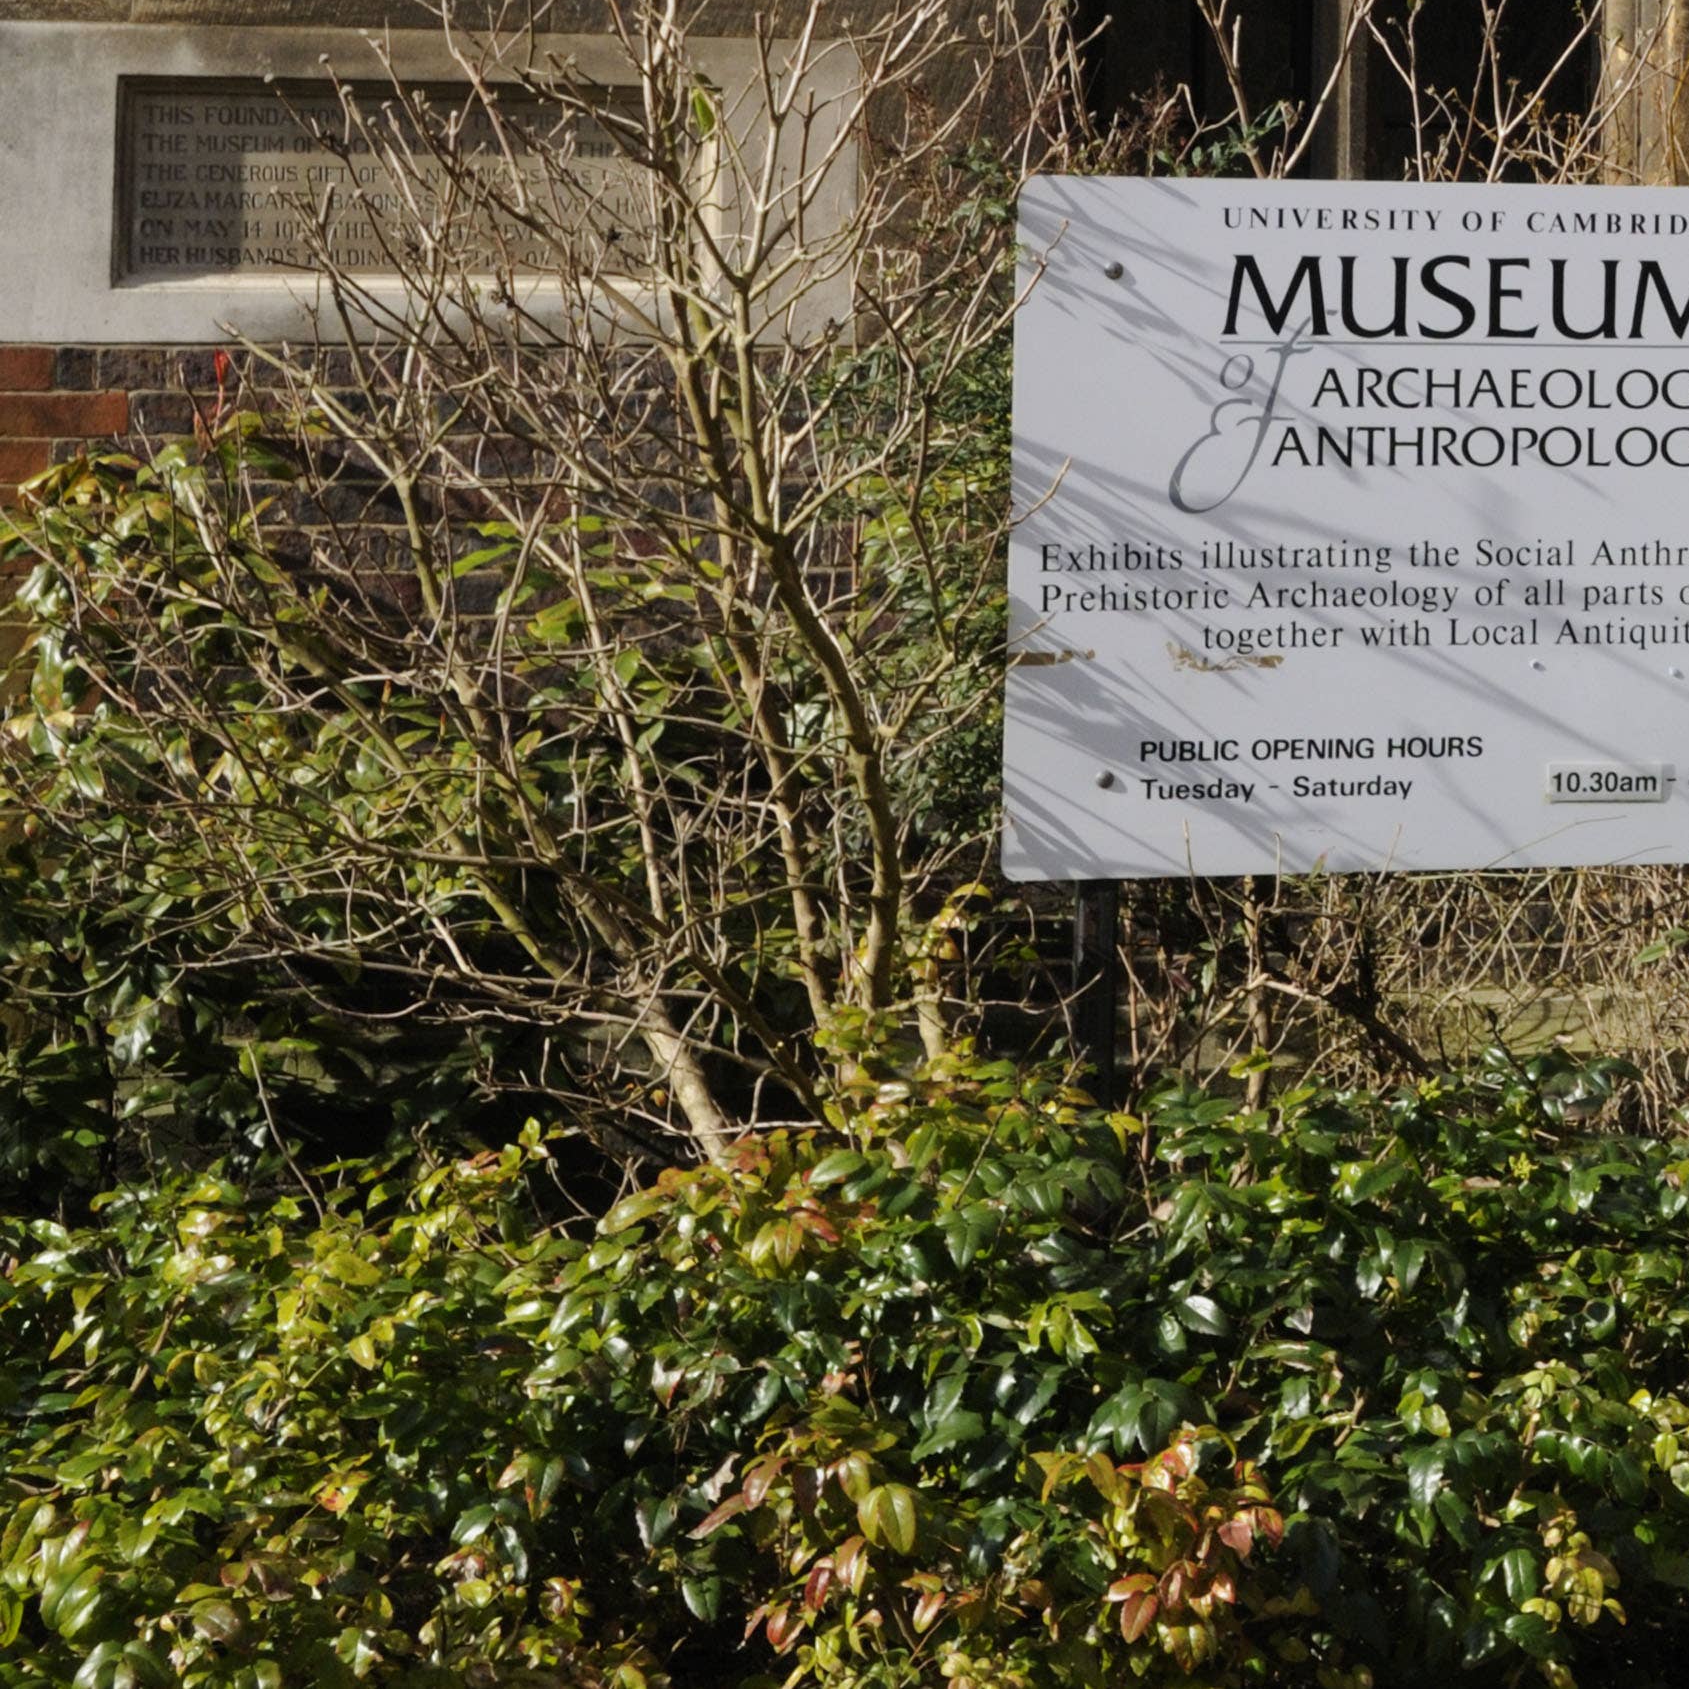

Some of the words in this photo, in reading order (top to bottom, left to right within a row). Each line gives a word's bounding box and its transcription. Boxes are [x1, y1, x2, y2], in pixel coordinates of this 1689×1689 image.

[144, 106, 194, 124] THIS
[143, 134, 188, 152] THE
[196, 136, 283, 153] MUSEUM
[143, 164, 188, 182] THE
[358, 165, 382, 183] OF
[140, 190, 198, 209] ELIZA
[140, 220, 173, 238] ON
[184, 221, 236, 238] MAY
[1223, 207, 1443, 232] UNIVERSITY
[1461, 210, 1507, 232] OF
[140, 248, 179, 265] HER
[1040, 542, 1184, 572] Exhibits
[1200, 540, 1393, 572] illustrating
[1409, 540, 1460, 567] the
[1475, 539, 1575, 567] Social
[1041, 581, 1229, 611] Prehistoric
[1245, 580, 1459, 611] Archaeology
[1474, 578, 1510, 606] of
[1523, 578, 1565, 606] all
[1583, 581, 1664, 610] parts
[1203, 621, 1343, 652] together
[1360, 619, 1430, 647] with
[1447, 618, 1539, 646] Local
[1140, 740, 1240, 762] PUBLIC
[1252, 738, 1375, 760] OPENING
[1387, 736, 1484, 758] HOURS
[1140, 778, 1255, 803] Tuesday
[1292, 775, 1413, 800] Saturday
[1552, 771, 1658, 793] 10.30am
